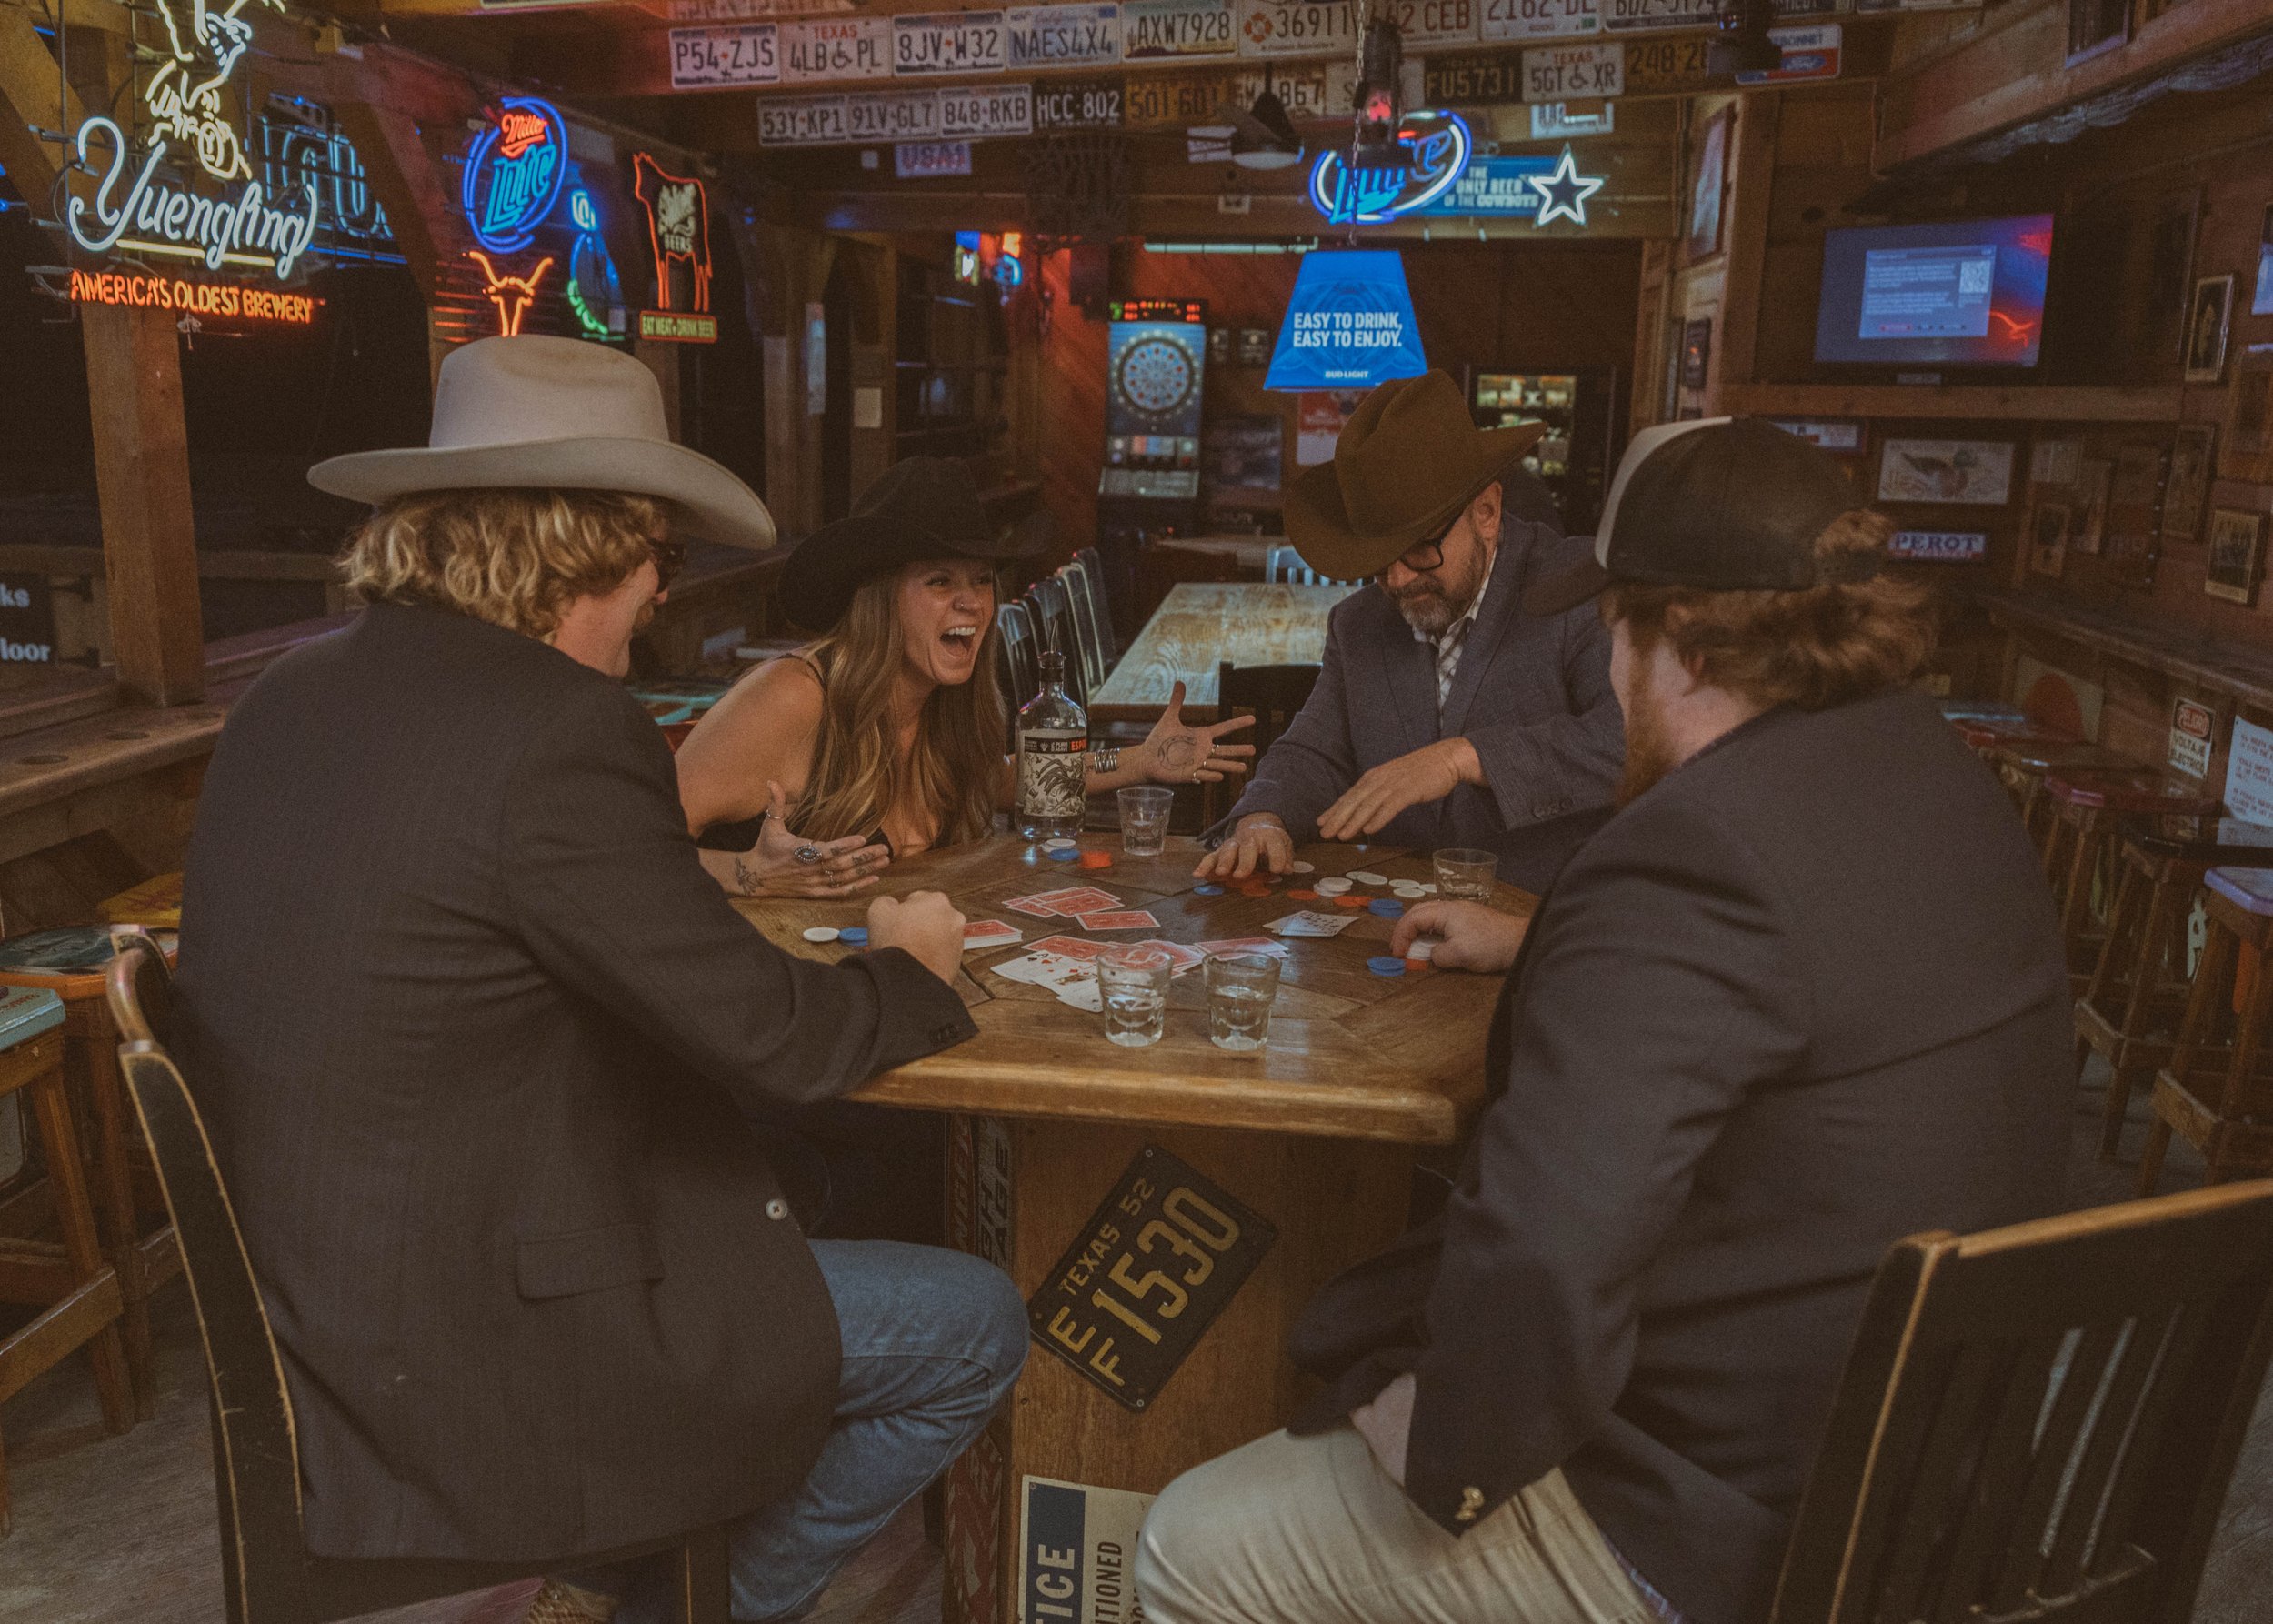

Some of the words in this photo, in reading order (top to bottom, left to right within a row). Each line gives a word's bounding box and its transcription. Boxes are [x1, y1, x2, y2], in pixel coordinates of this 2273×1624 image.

[813, 24, 858, 40] TEXAS
[1137, 10, 1230, 46] AXW7928
[1275, 5, 1348, 39] 36911
[1425, 1, 1470, 32] CEB
[1013, 25, 1113, 59] NAES4X4
[1552, 50, 1594, 65] TEXAS
[501, 113, 548, 144] Miller
[68, 115, 319, 281] Yuengling
[482, 144, 557, 234] Lite
[70, 268, 172, 310] AMERICA'S
[173, 280, 242, 316] OLDEST
[242, 292, 314, 325] BREWERY
[1293, 311, 1331, 330] EASY
[1333, 311, 1353, 330] TO
[1354, 311, 1403, 331] DRINK,
[1292, 330, 1331, 348] EASY
[1333, 330, 1353, 348] TO
[1354, 330, 1403, 348] ENJOY.
[1896, 533, 1978, 552] PEROT
[1057, 1222, 1121, 1296] TEXAS
[1118, 1177, 1156, 1217] 52
[1090, 1185, 1242, 1346] 1530
[1036, 1543, 1076, 1624] ICE
